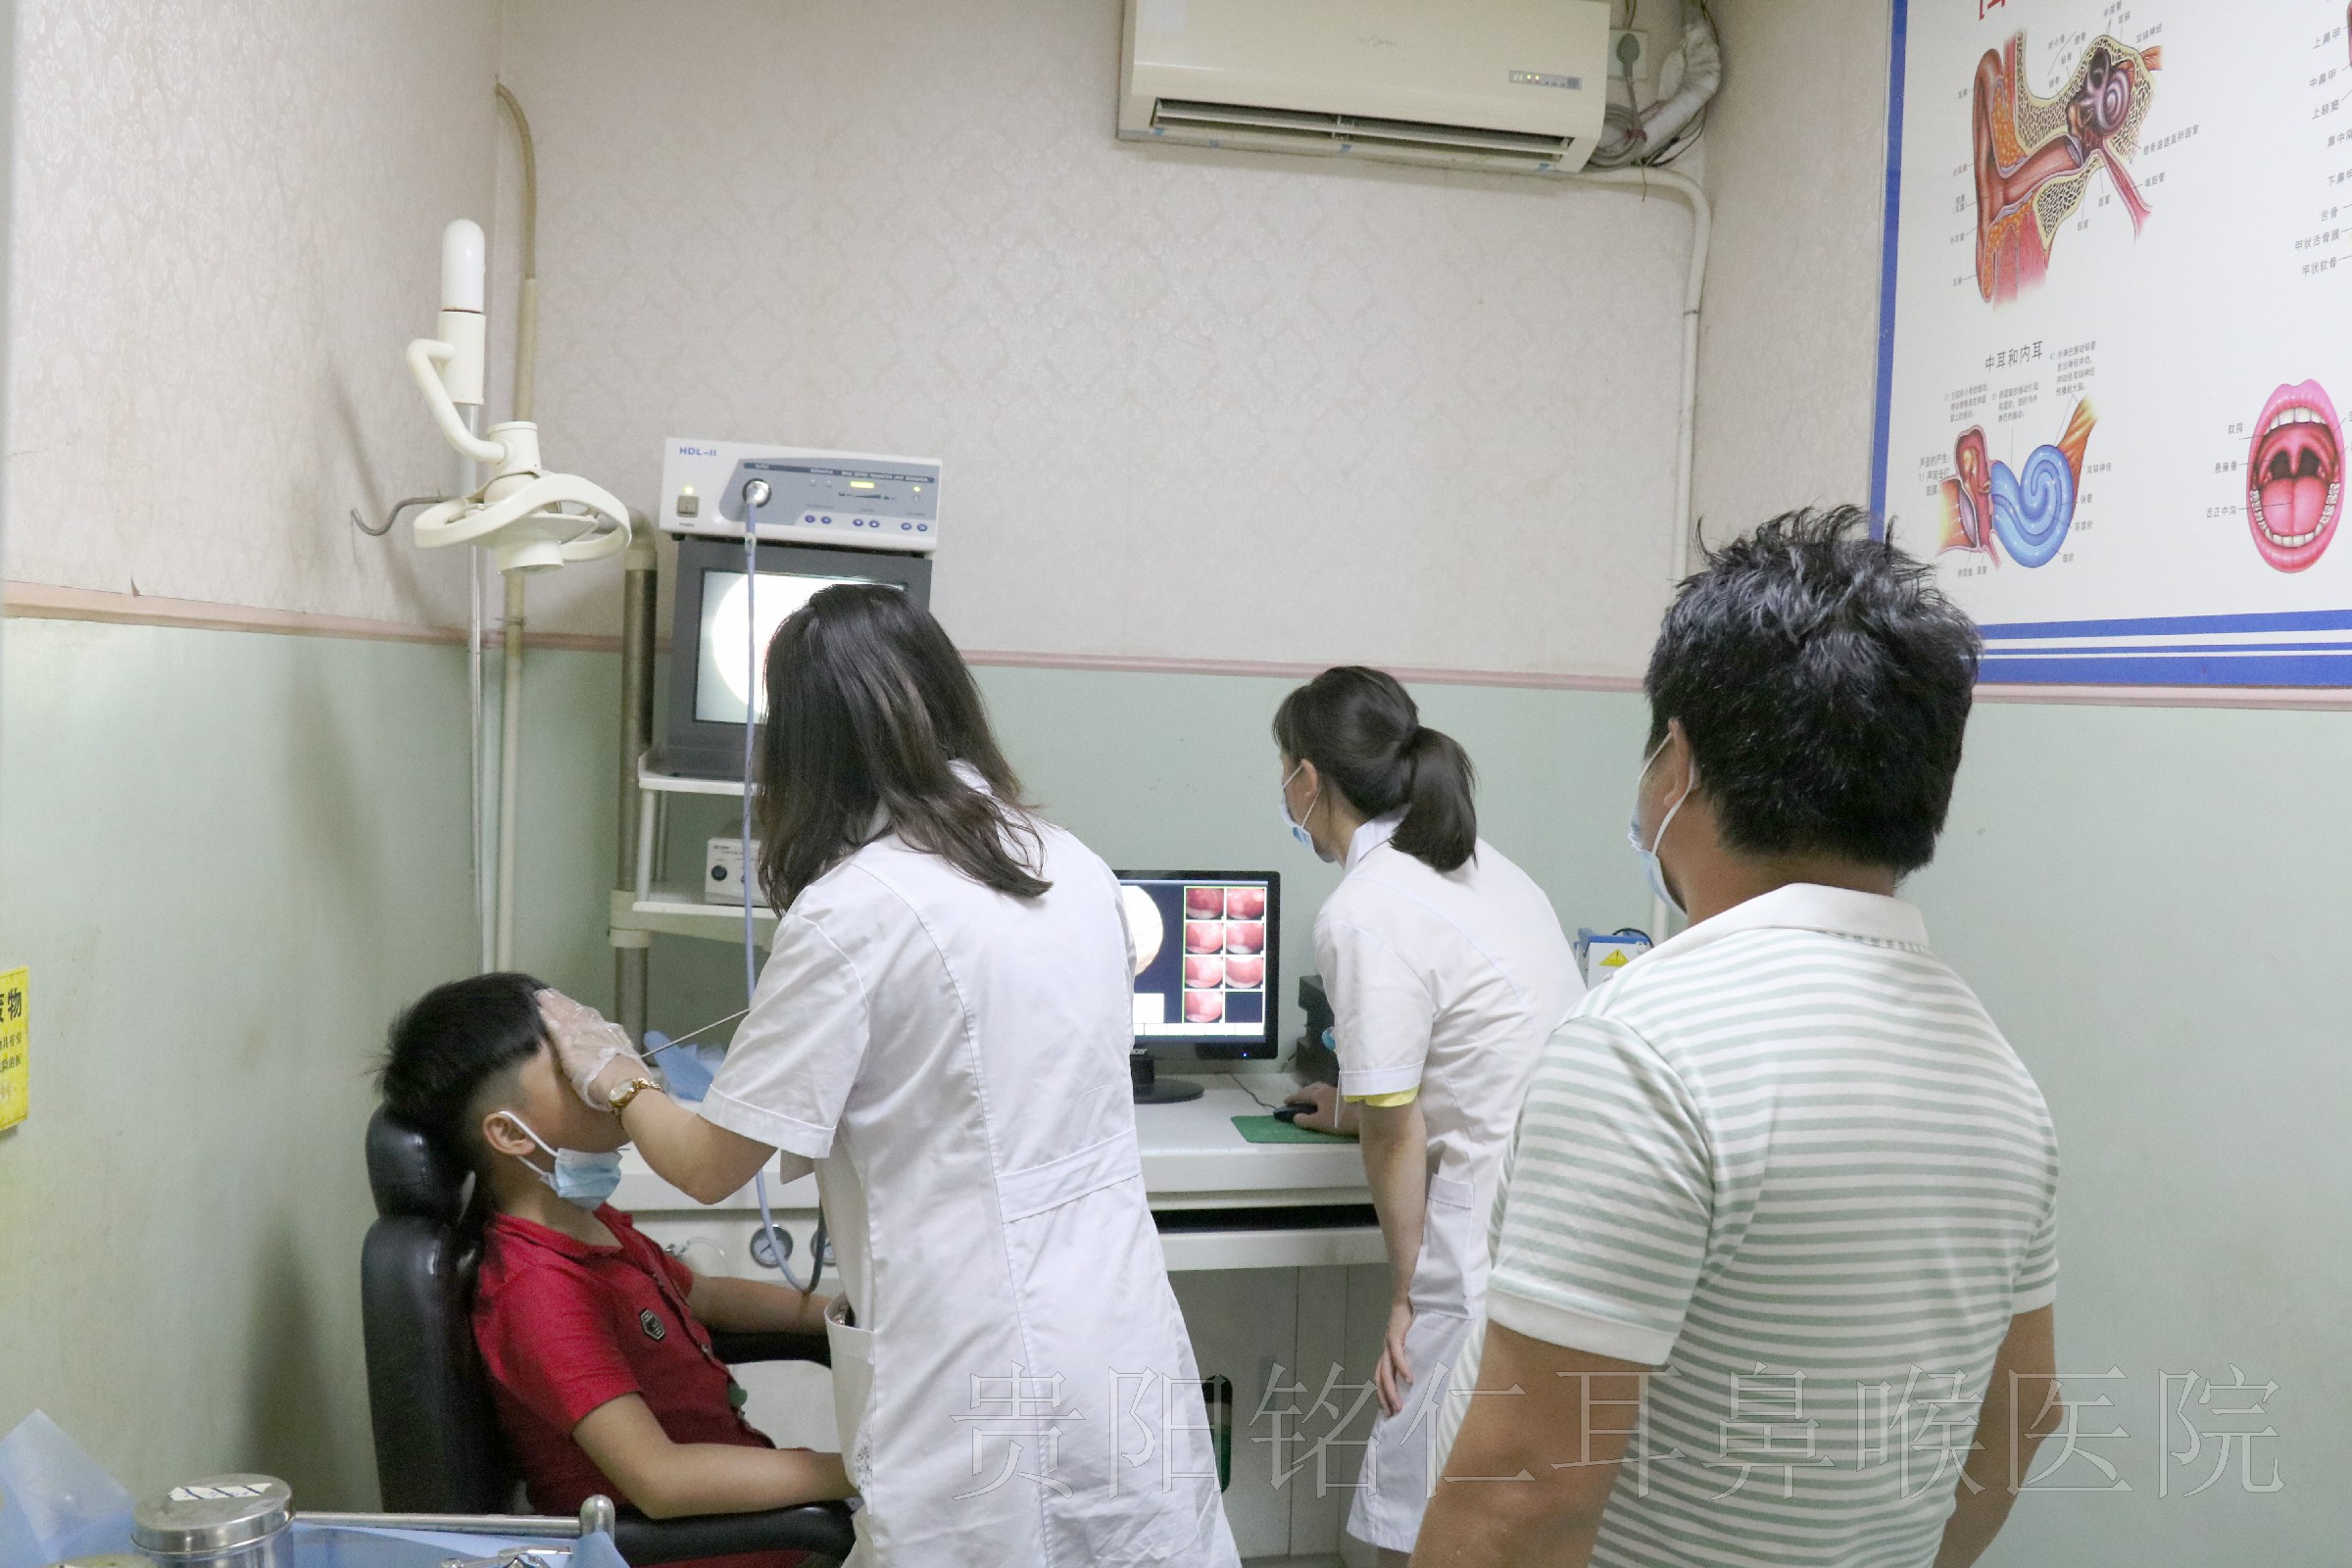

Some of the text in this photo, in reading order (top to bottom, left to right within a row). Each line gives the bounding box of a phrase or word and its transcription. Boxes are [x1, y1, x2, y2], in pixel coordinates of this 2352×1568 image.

[2309, 69, 2336, 88] 中鼻甲
[2302, 257, 2337, 276] 甲状软骨
[1984, 340, 2043, 373] 中耳和内耳
[2206, 505, 2237, 518] 舌正中沟
